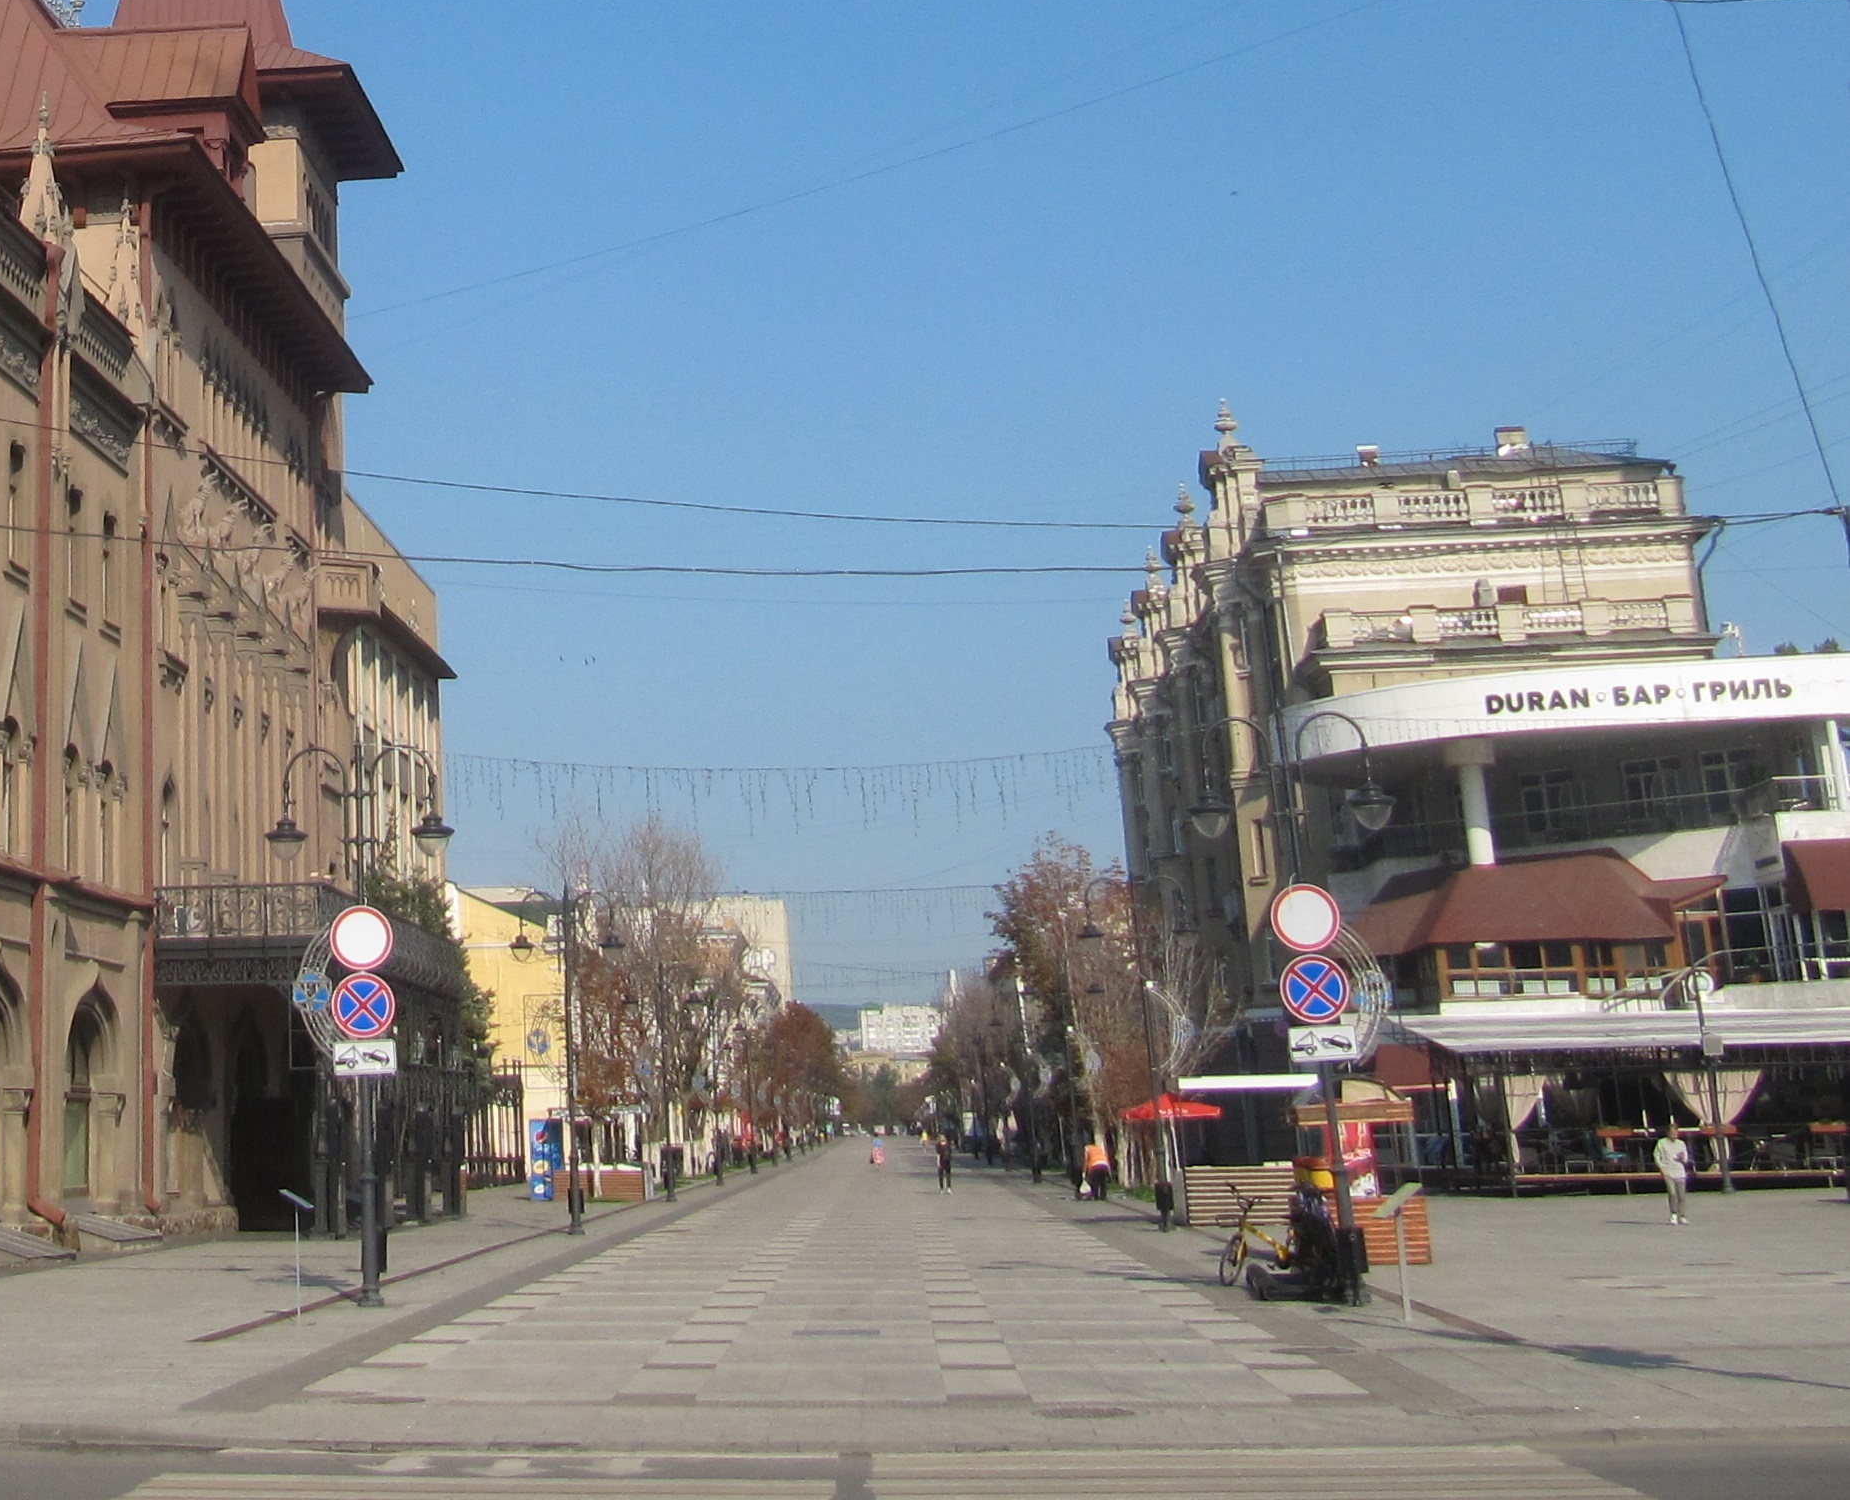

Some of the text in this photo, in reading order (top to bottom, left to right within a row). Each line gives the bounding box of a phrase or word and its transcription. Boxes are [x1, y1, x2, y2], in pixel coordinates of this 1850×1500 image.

[1485, 678, 1792, 715] DURAN БАР ГРИЛЬ
